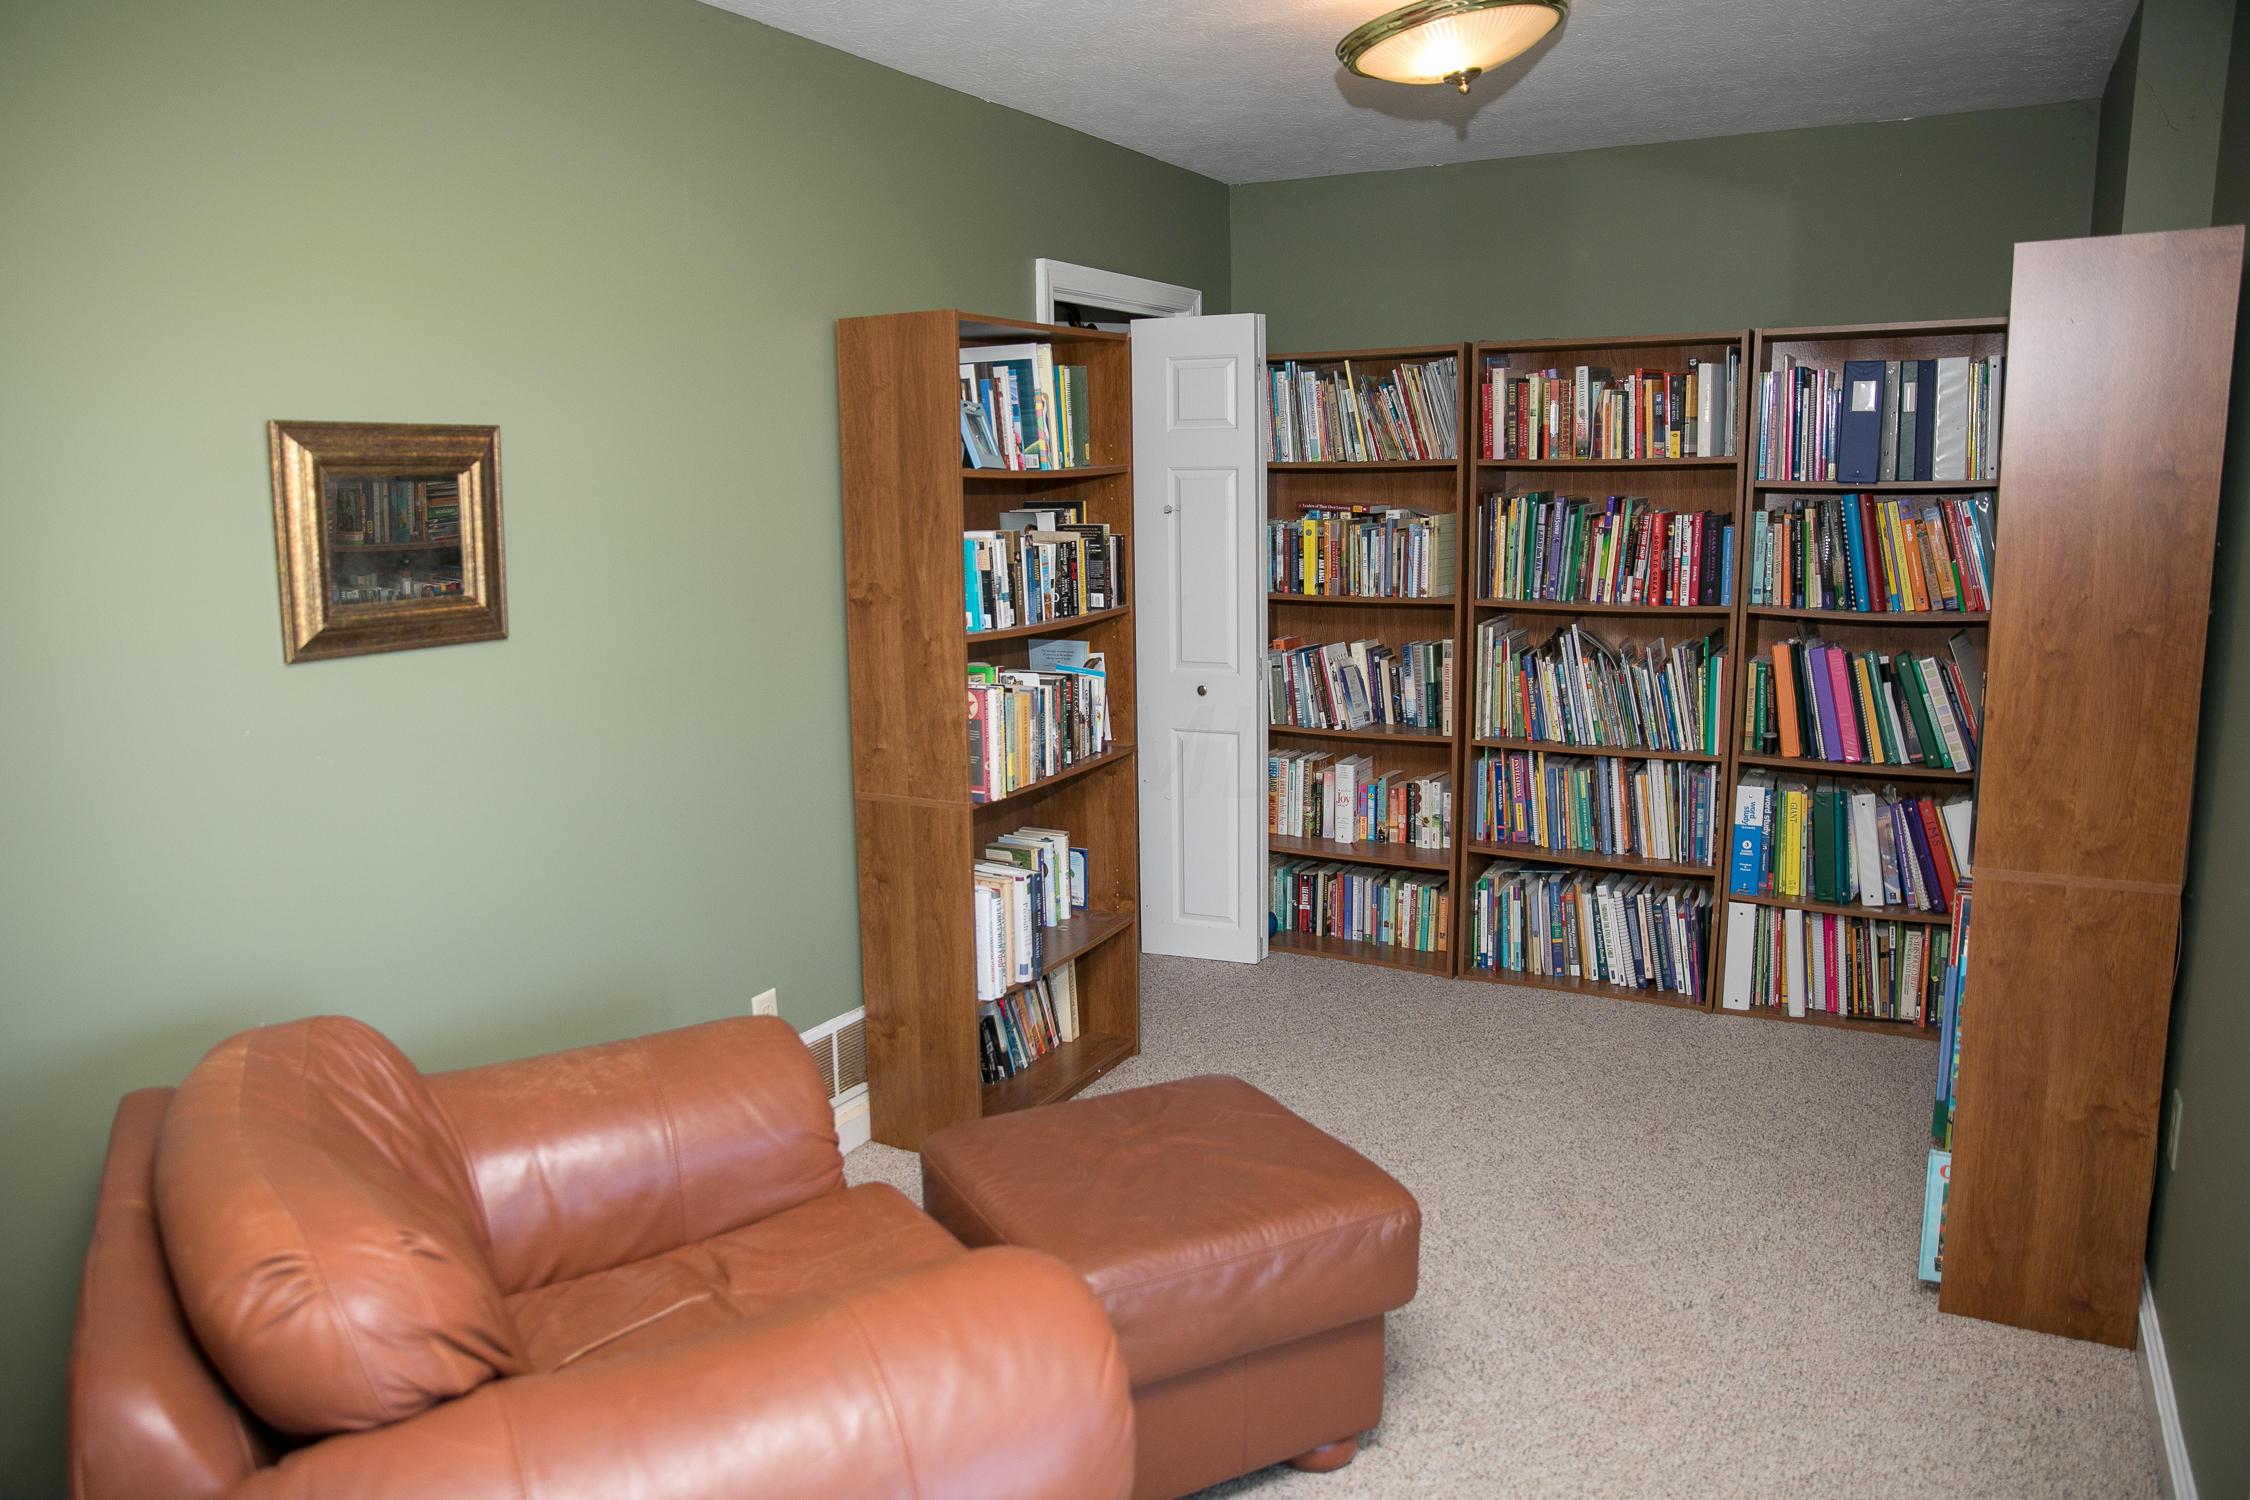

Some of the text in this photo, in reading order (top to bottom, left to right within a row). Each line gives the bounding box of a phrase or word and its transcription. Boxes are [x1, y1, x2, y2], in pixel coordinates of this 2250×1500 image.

[1905, 523, 1913, 543] Math
[1402, 646, 1412, 678] HONEYMOON
[1269, 761, 1278, 793] LIFEGUARD
[1514, 759, 1522, 798] INVITATIONS
[1742, 806, 1751, 825] study
[1749, 802, 1757, 819] word
[1761, 795, 1772, 836] word study
[1789, 802, 1798, 824] GIANT
